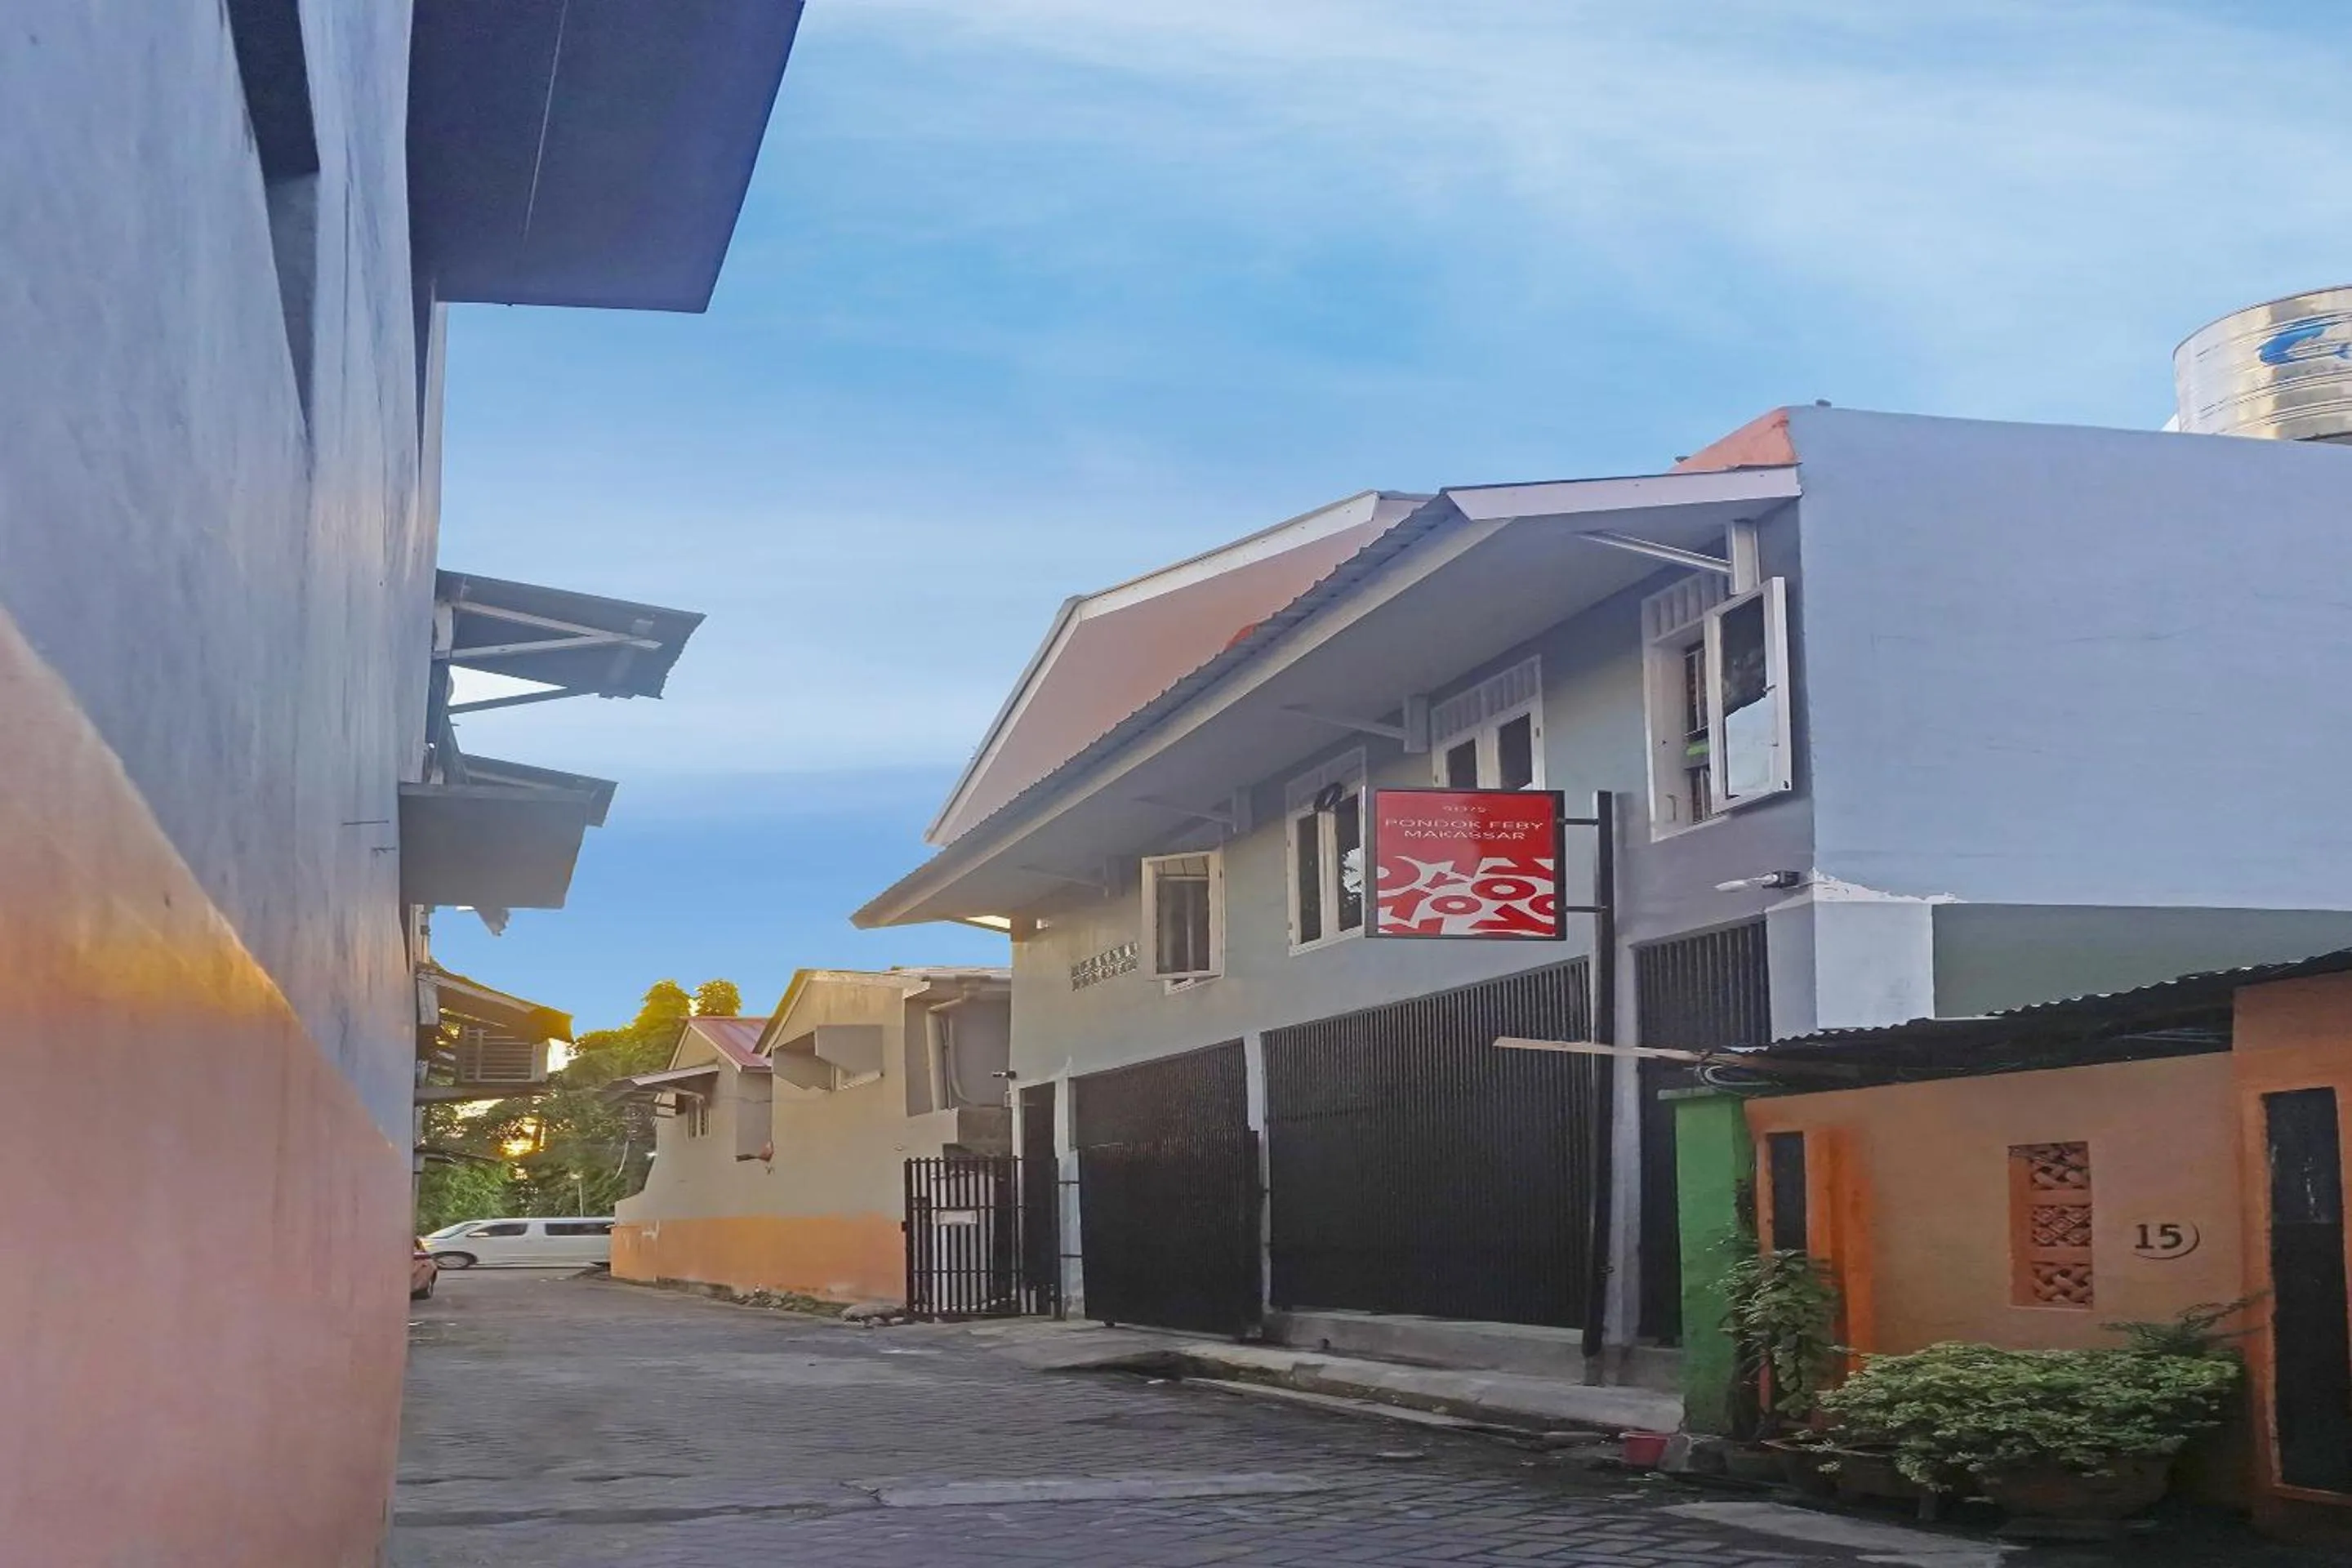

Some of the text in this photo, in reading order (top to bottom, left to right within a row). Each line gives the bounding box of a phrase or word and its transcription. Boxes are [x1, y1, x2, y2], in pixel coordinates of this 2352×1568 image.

[1385, 818, 1481, 829] PONDOK
[1404, 830, 1526, 840] MAKASSAR
[2135, 1223, 2184, 1250] 15
